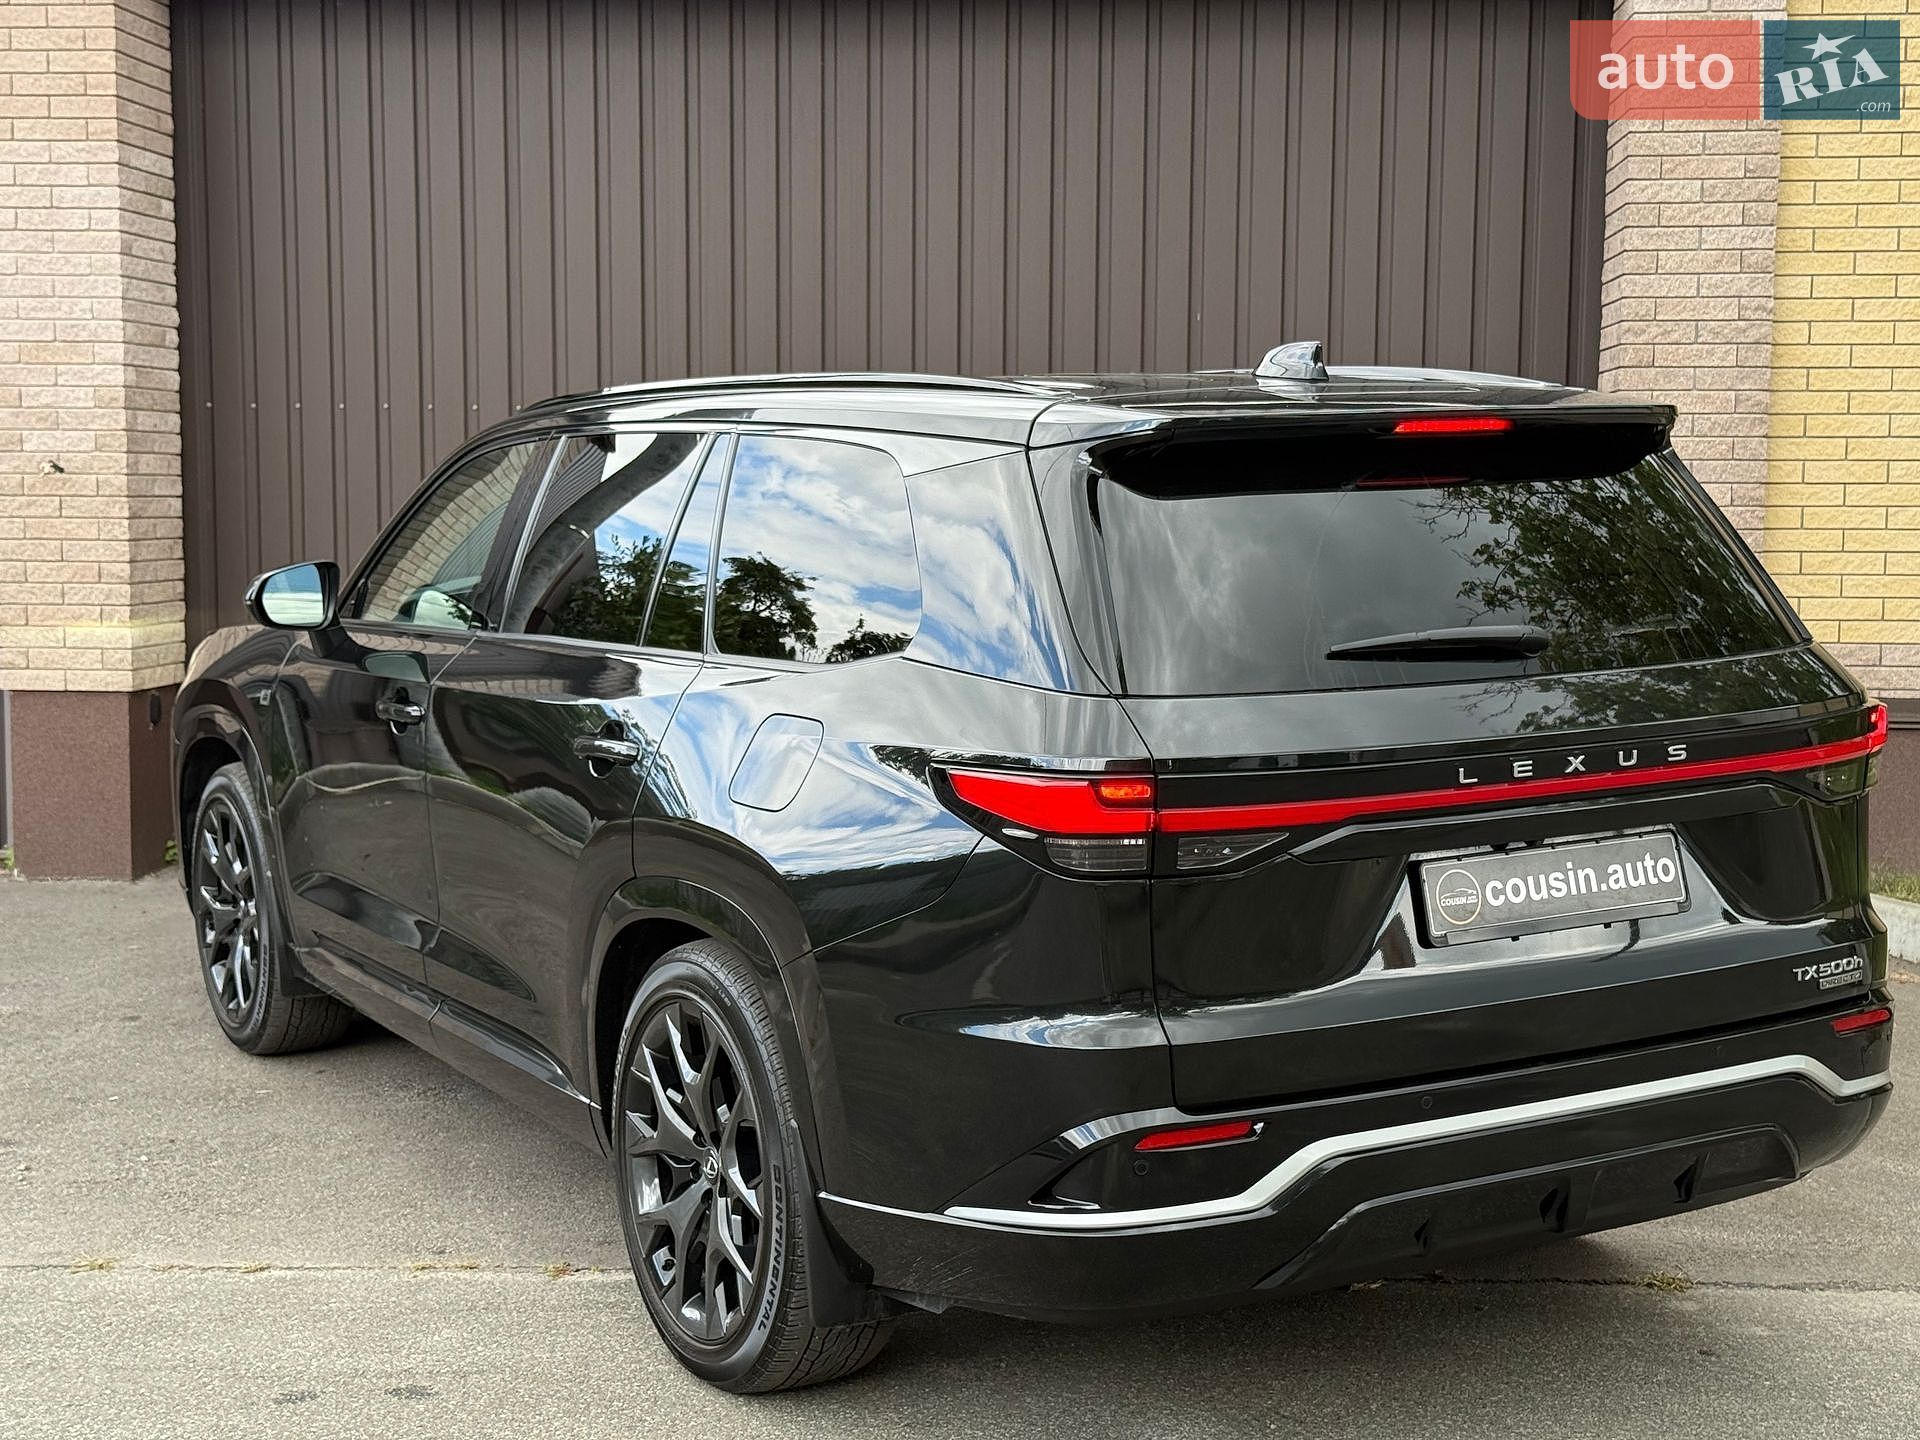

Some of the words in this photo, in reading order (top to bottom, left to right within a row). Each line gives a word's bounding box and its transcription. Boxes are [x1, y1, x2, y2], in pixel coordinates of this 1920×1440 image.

[1458, 744, 1687, 785] LEXUS
[1485, 852, 1676, 907] cousin.auto
[1440, 896, 1467, 907] COUSIN
[1792, 955, 1863, 982] TX500h
[757, 1163, 784, 1332] CONTINENTAL
